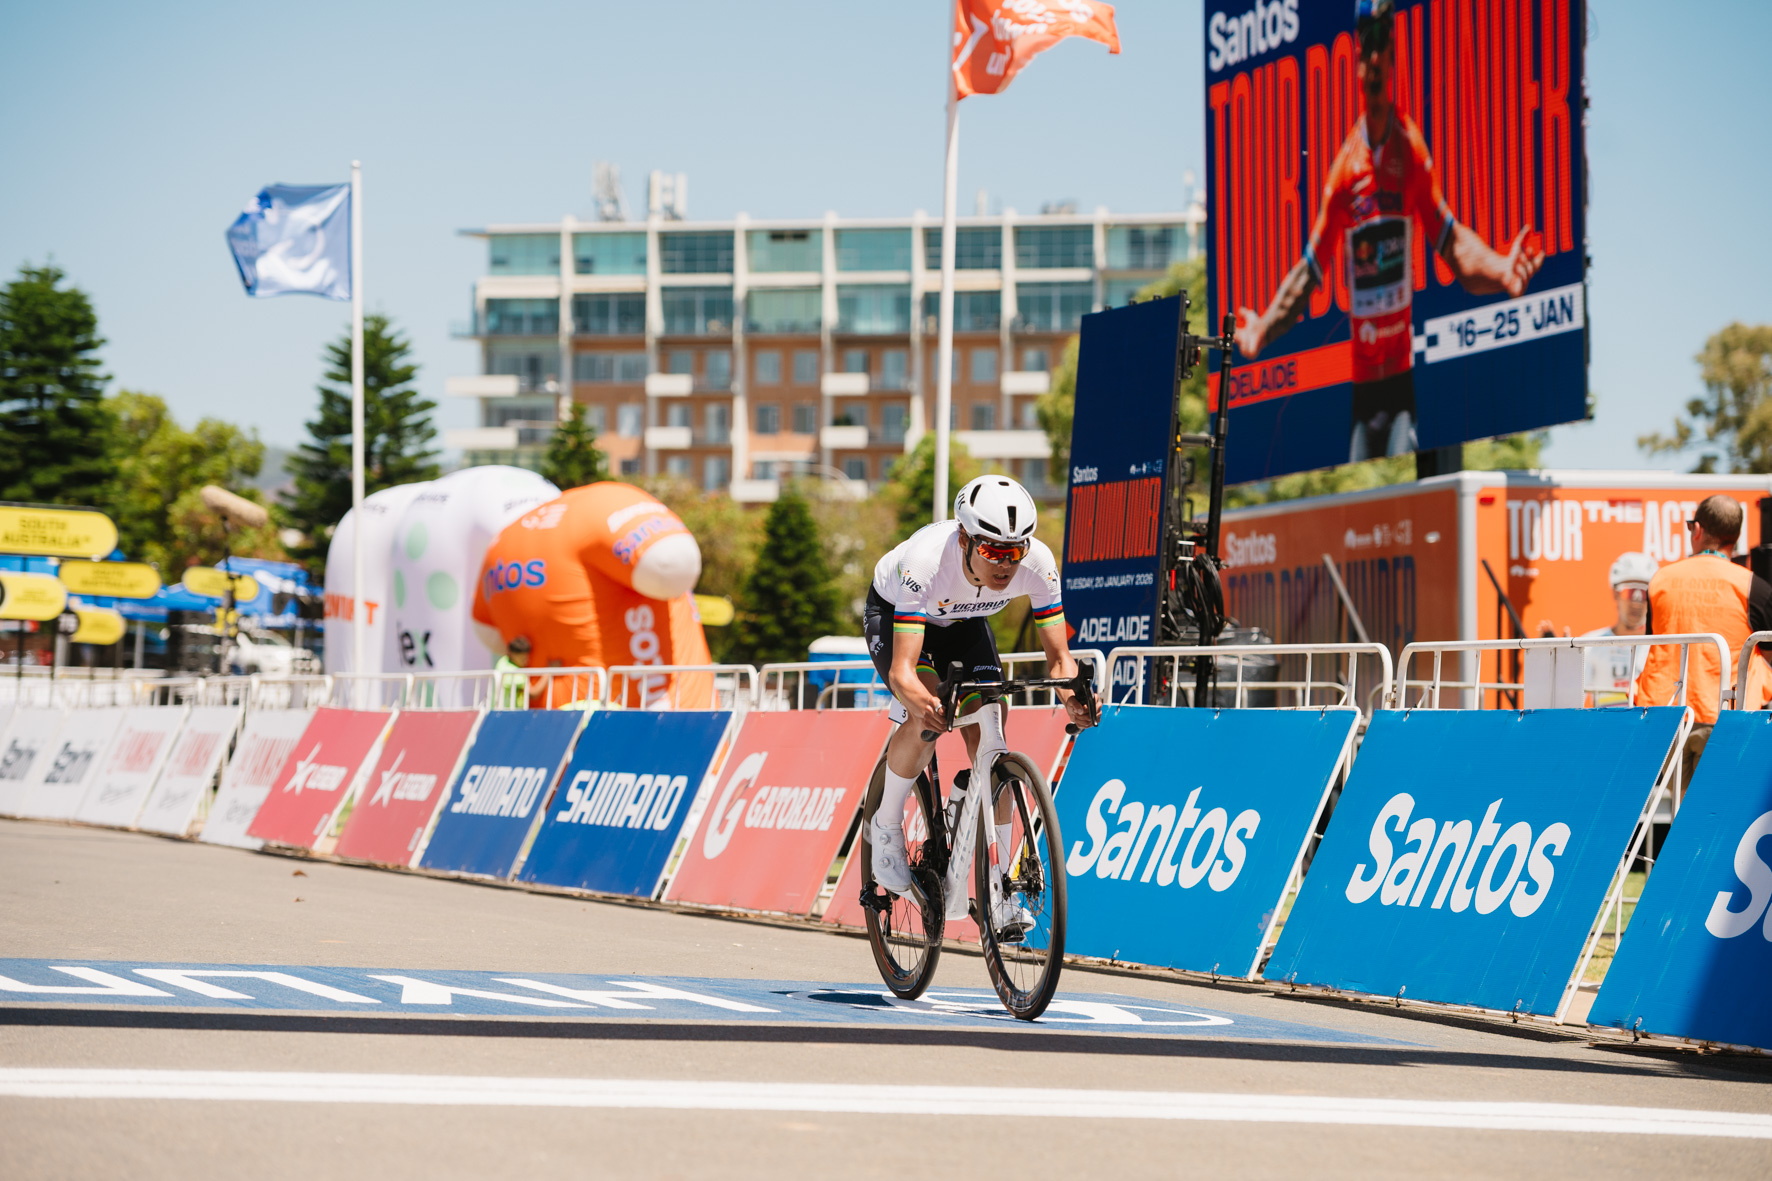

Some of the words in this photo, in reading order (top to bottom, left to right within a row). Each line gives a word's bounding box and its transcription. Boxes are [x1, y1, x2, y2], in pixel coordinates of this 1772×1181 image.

[1209, 0, 1299, 72] Santos
[1209, 55, 1301, 337] TOUR
[1305, 4, 1428, 319] DON
[1227, 360, 1297, 401] DELAIDE
[1072, 465, 1099, 484] Santos
[1225, 531, 1277, 568] Santos
[1507, 500, 1583, 561] TOUR
[1583, 500, 1643, 523] THE
[484, 559, 545, 602] ntos
[1094, 576, 1104, 588] 20
[1104, 574, 1134, 588] JANUARY
[399, 629, 434, 667] ex
[1078, 615, 1151, 642] ADELAIDE
[450, 764, 548, 819] SHIMANO
[556, 769, 689, 832] SHIMANO
[745, 786, 847, 832] GATORADE
[1066, 778, 1261, 892] Santos
[1345, 792, 1572, 918] Santos
[1704, 810, 1772, 942] S
